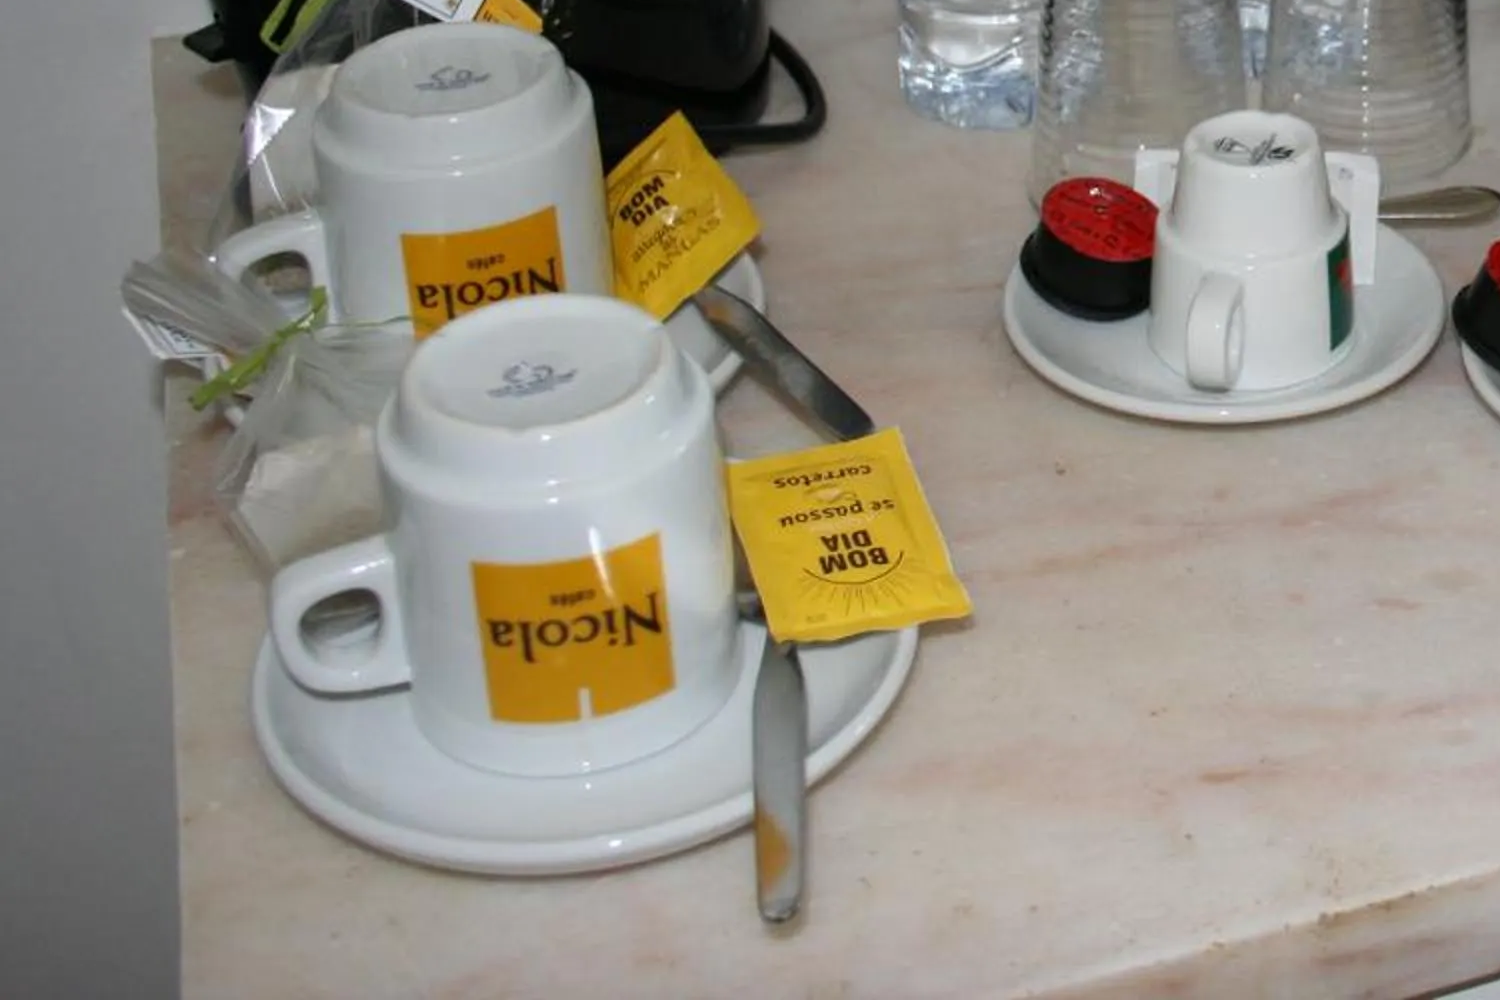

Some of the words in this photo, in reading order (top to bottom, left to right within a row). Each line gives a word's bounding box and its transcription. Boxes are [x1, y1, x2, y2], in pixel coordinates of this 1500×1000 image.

[619, 175, 665, 221] BOM
[631, 195, 670, 227] DIA
[416, 256, 562, 320] Nicola
[772, 463, 873, 489] carretos
[779, 499, 864, 529] passou
[870, 498, 896, 513] se
[820, 529, 873, 552] DIA
[818, 547, 890, 575] BOM
[486, 591, 664, 664] Nicola
